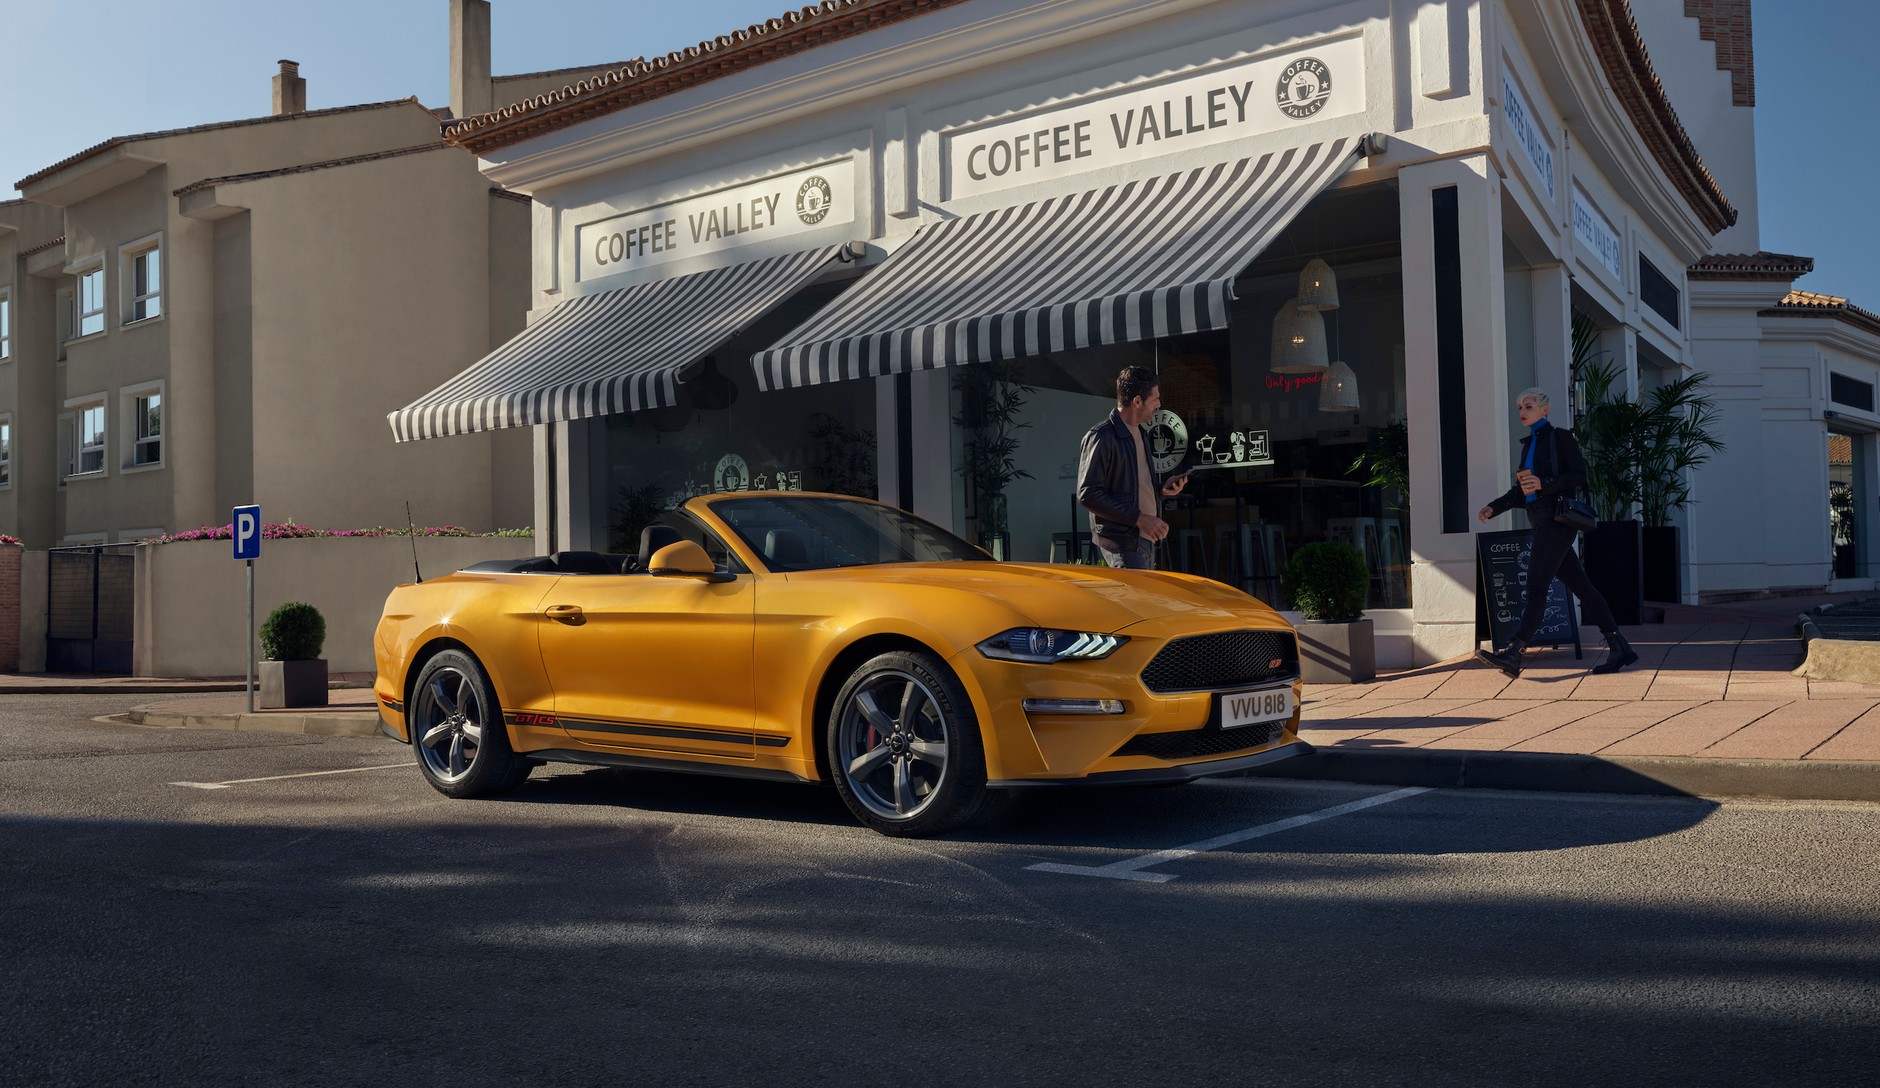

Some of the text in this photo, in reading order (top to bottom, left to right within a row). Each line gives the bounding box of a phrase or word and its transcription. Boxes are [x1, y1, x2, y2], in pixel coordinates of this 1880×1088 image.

[1281, 60, 1324, 84] COFFEE
[1288, 100, 1322, 117] VALLEY
[967, 80, 1254, 181] COFFEE VALLEY
[1525, 118, 1545, 178] VALLEY
[800, 177, 827, 197] COFFEE
[803, 210, 825, 223] VALLEY
[595, 192, 780, 267] COFFEE VALLEY
[1264, 375, 1291, 393] Only
[1293, 371, 1321, 390] good
[718, 457, 744, 473] COFFEE
[1156, 456, 1177, 470] LLEY
[238, 513, 255, 554] P
[1490, 543, 1521, 553] COFFEE
[914, 667, 953, 715] MICHELIN
[1231, 694, 1285, 719] VVU 818
